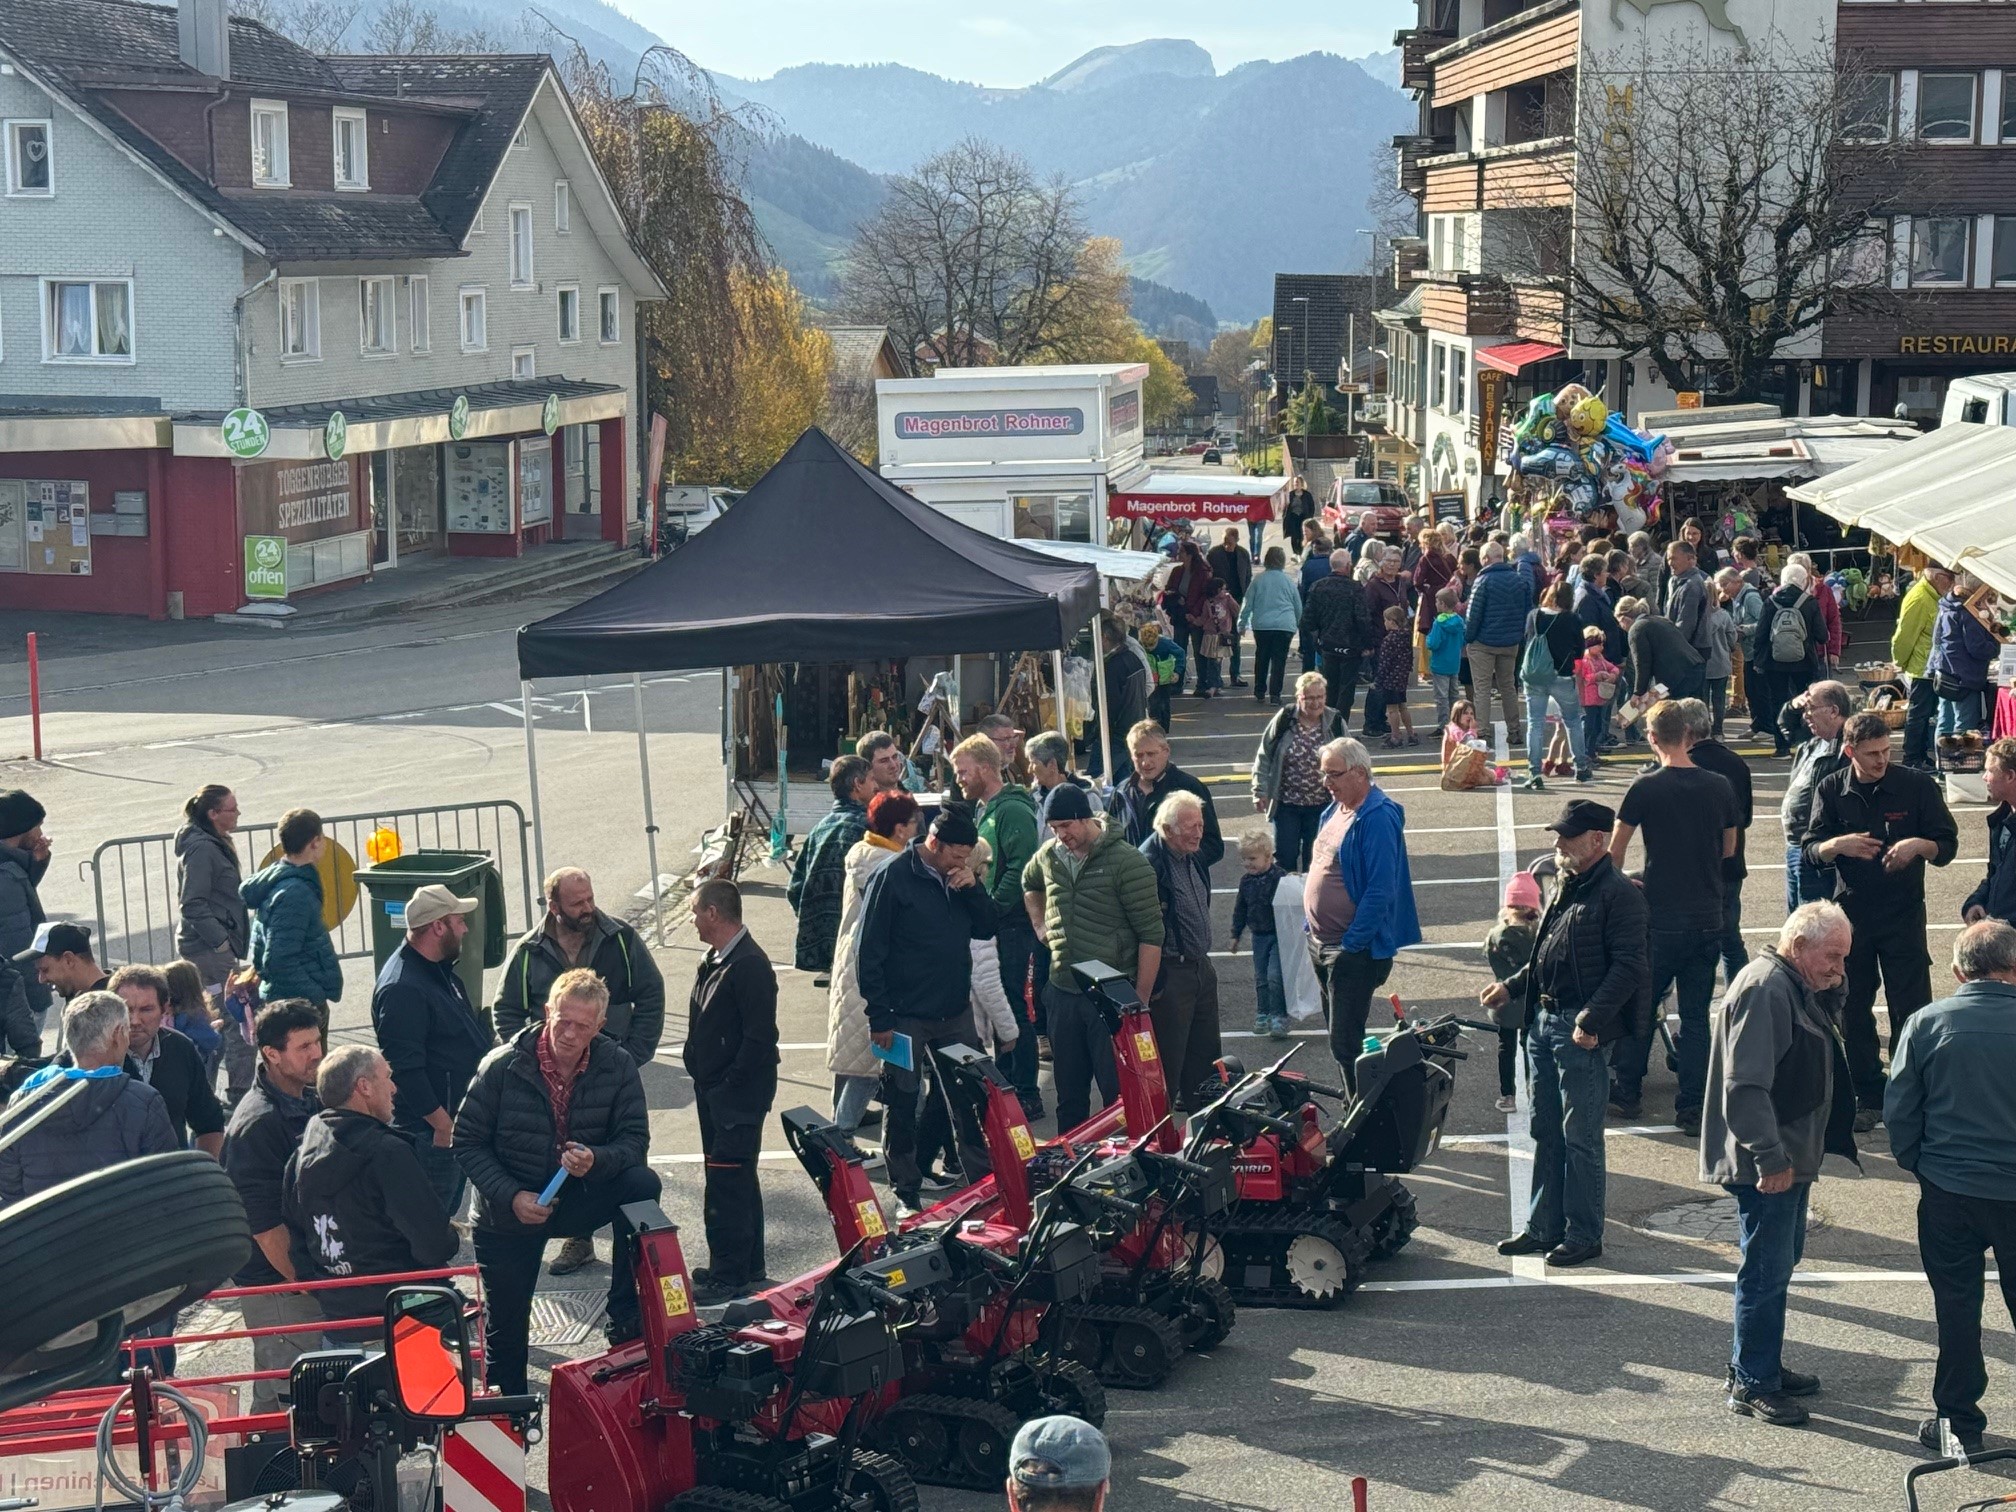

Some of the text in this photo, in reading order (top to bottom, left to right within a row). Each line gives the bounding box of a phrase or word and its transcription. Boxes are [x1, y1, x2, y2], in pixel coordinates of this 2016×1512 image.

[225, 412, 263, 441] 24
[328, 416, 345, 444] 24
[904, 413, 1071, 435] Magenbrot Rohner
[1483, 384, 1495, 467] RESTAURANT
[230, 434, 266, 453] STUNDEN
[277, 461, 349, 496] TOGGENBURGER
[278, 491, 350, 529] SPEZIALITÄTEN
[1127, 500, 1250, 514] Magenbrot Rohner
[257, 542, 278, 558] 24
[249, 567, 284, 585] offen
